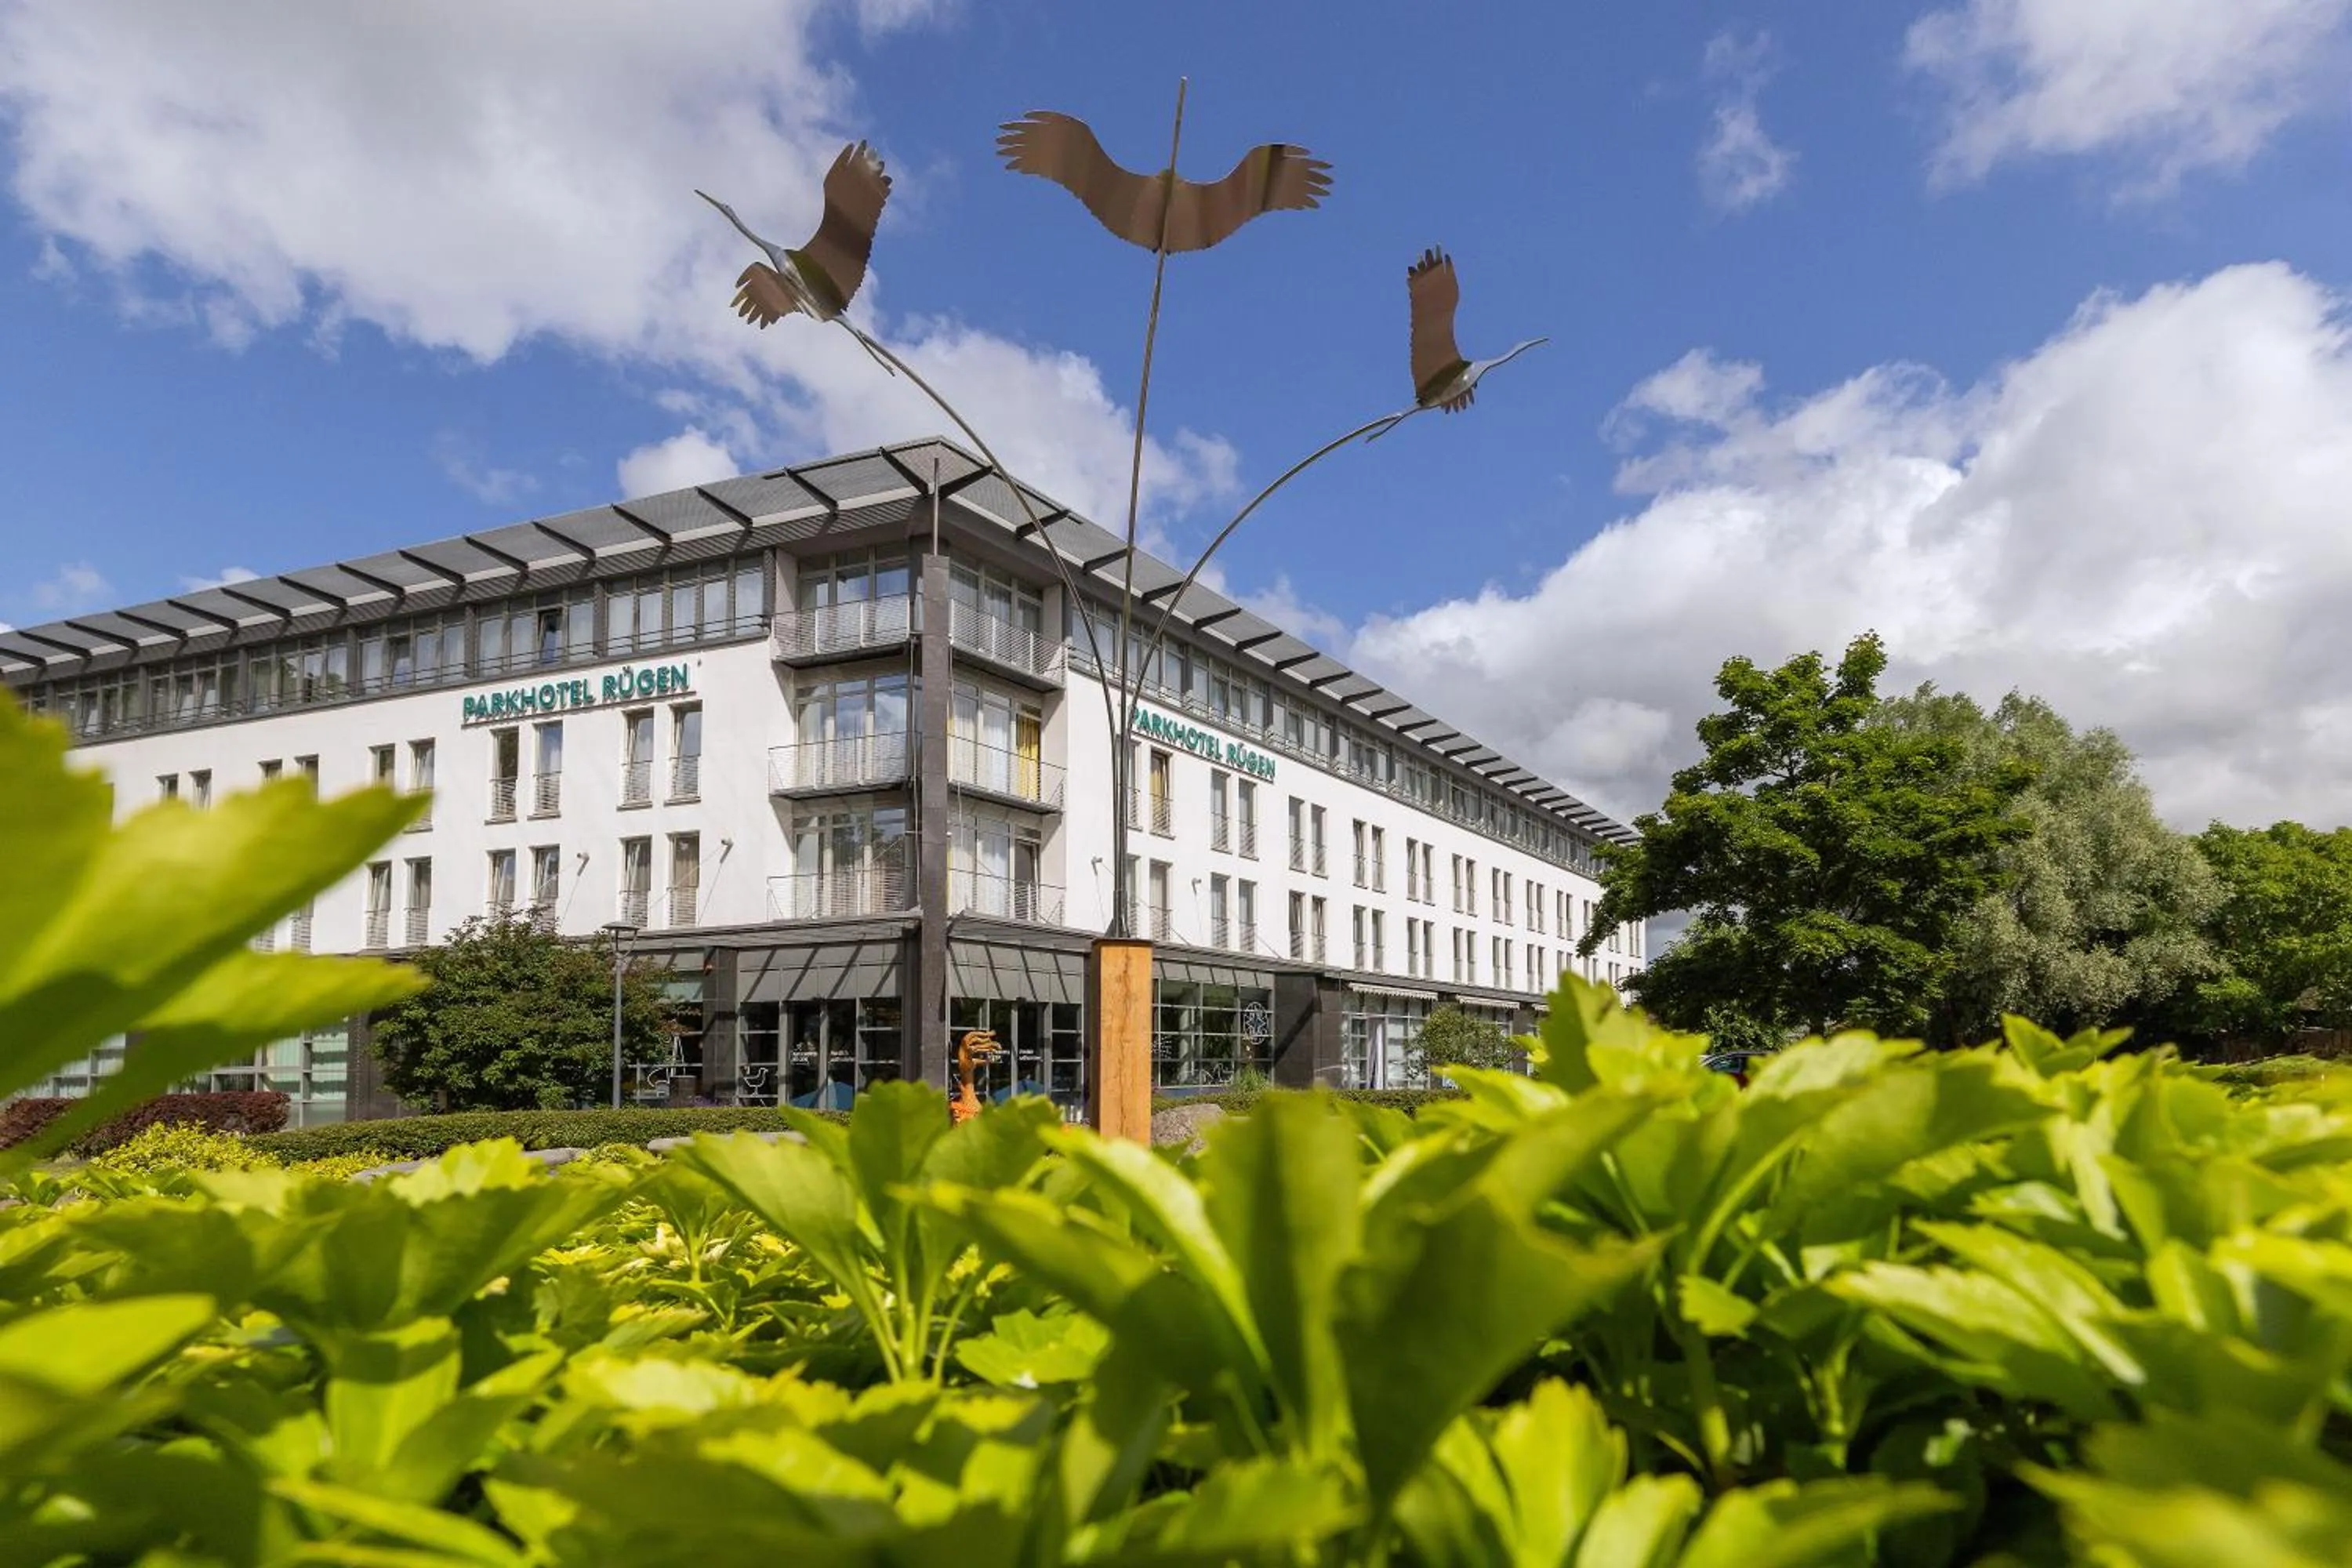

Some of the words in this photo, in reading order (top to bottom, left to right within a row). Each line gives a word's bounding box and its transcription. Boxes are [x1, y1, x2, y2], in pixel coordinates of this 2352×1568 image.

[463, 679, 593, 719] PARKHOTEL
[601, 663, 690, 699] RÜGEN
[1226, 742, 1276, 778] RÜGEN
